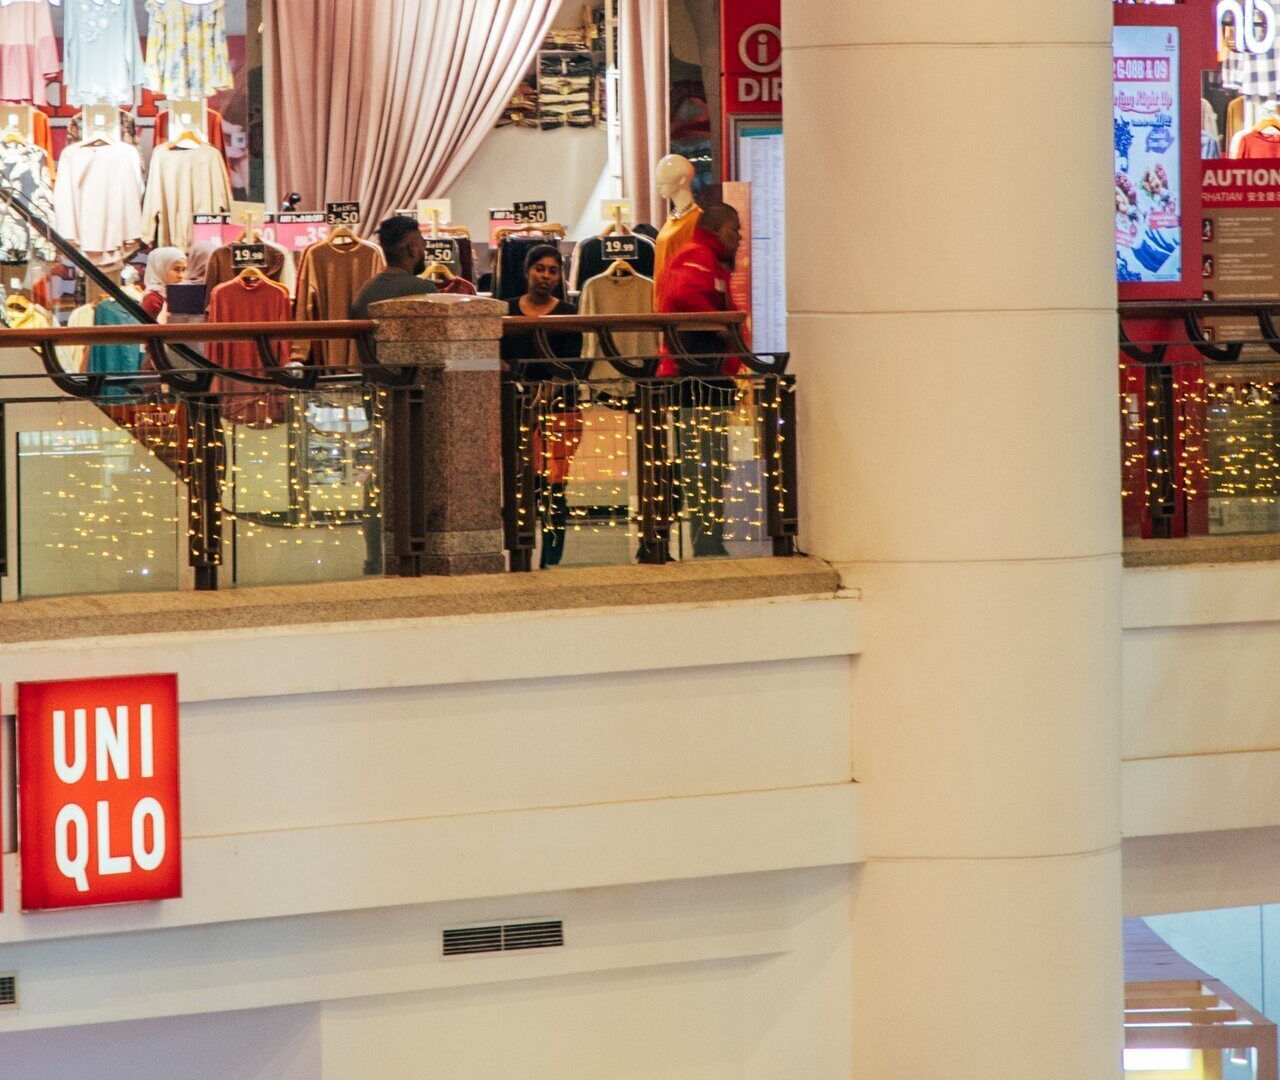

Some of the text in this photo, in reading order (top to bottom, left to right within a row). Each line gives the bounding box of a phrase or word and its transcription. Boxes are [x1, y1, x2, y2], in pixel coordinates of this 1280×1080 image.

[342, 212, 359, 224] 50
[528, 211, 545, 222] 50
[605, 240, 635, 253] 19.99
[435, 249, 452, 261] 50
[52, 703, 154, 785] UNI
[54, 796, 166, 892] QLO
